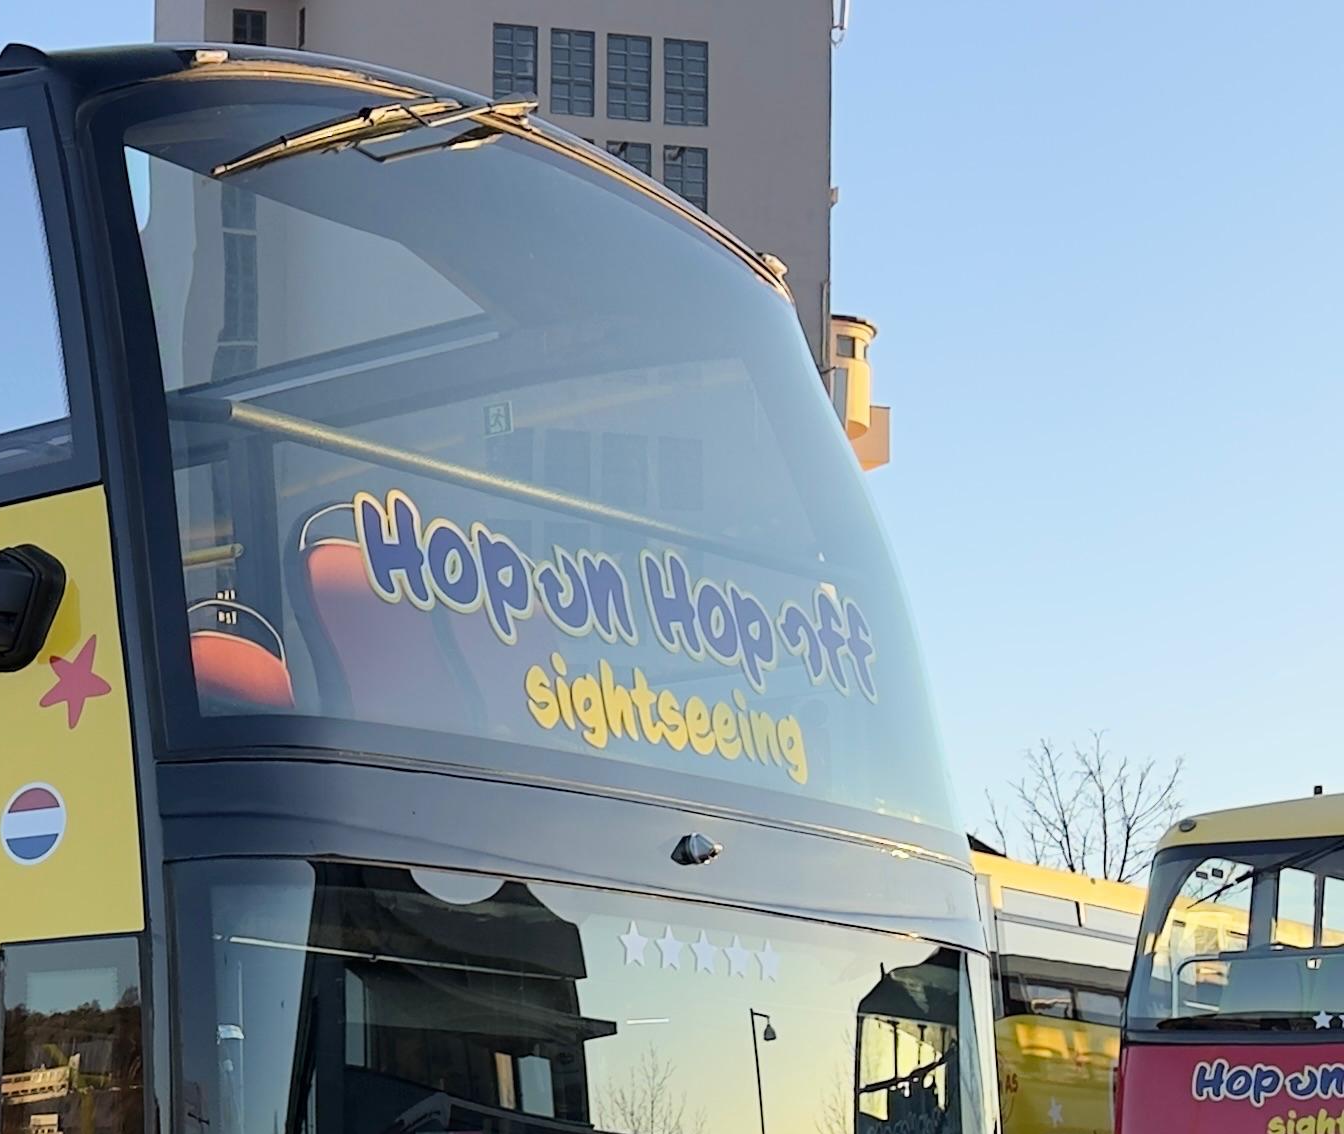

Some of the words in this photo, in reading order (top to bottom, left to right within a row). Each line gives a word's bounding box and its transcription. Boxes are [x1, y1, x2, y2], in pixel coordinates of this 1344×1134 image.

[354, 489, 536, 645] Hop
[534, 545, 640, 646] on
[640, 549, 778, 693] Hop
[779, 588, 878, 704] off
[525, 652, 808, 785] sightseeing
[1192, 1058, 1284, 1107] Hop
